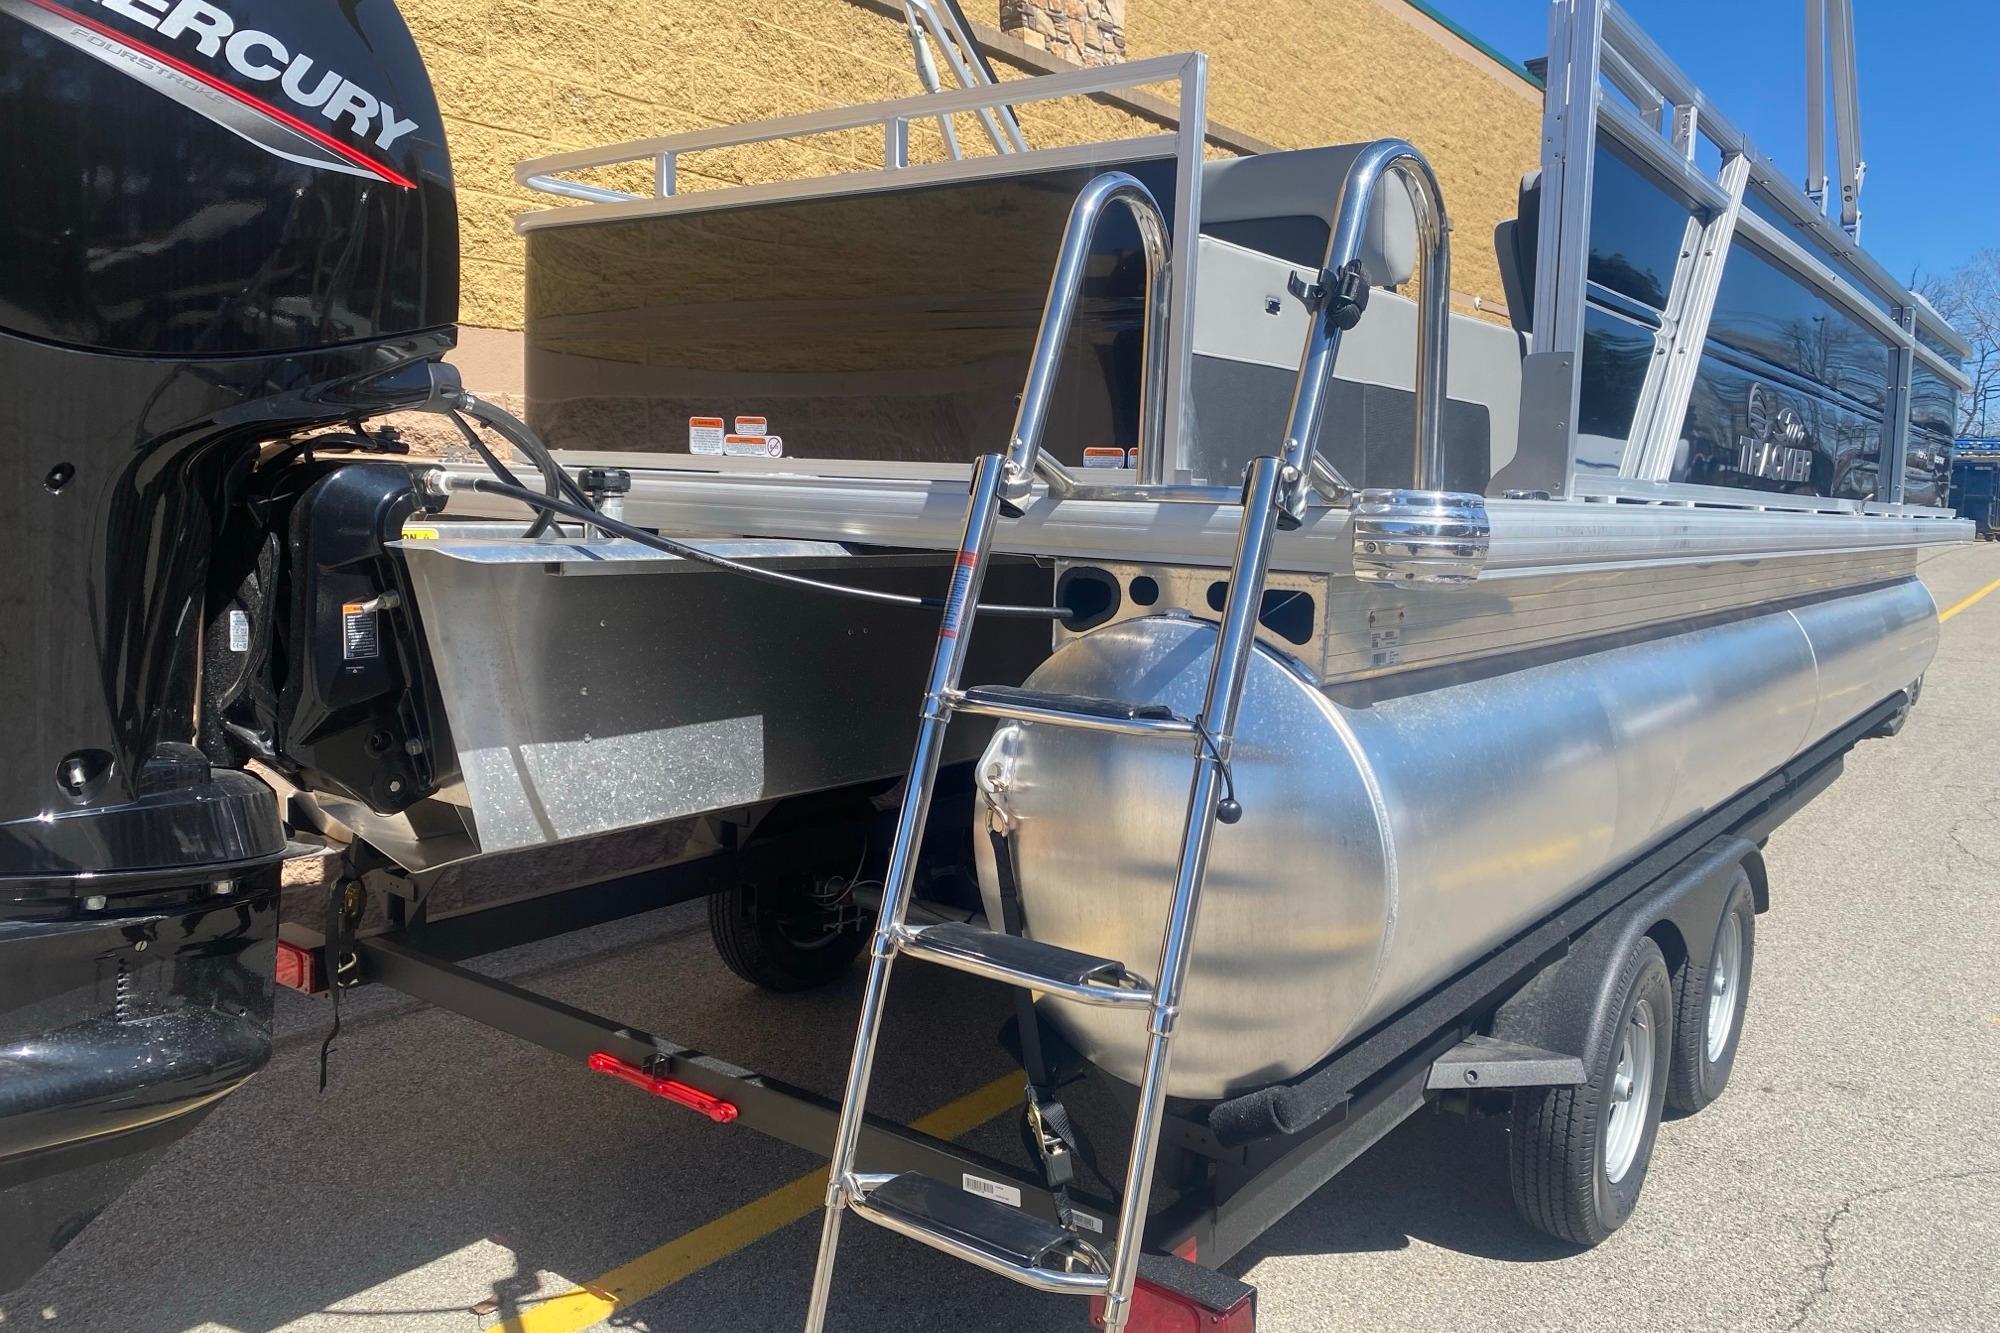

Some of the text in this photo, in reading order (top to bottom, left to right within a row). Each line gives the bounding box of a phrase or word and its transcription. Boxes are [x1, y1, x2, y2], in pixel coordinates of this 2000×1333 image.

[70, 27, 226, 104] FOURSTROKE
[92, 0, 419, 150] ERCURY
[1739, 435, 1813, 482] TRACKER
